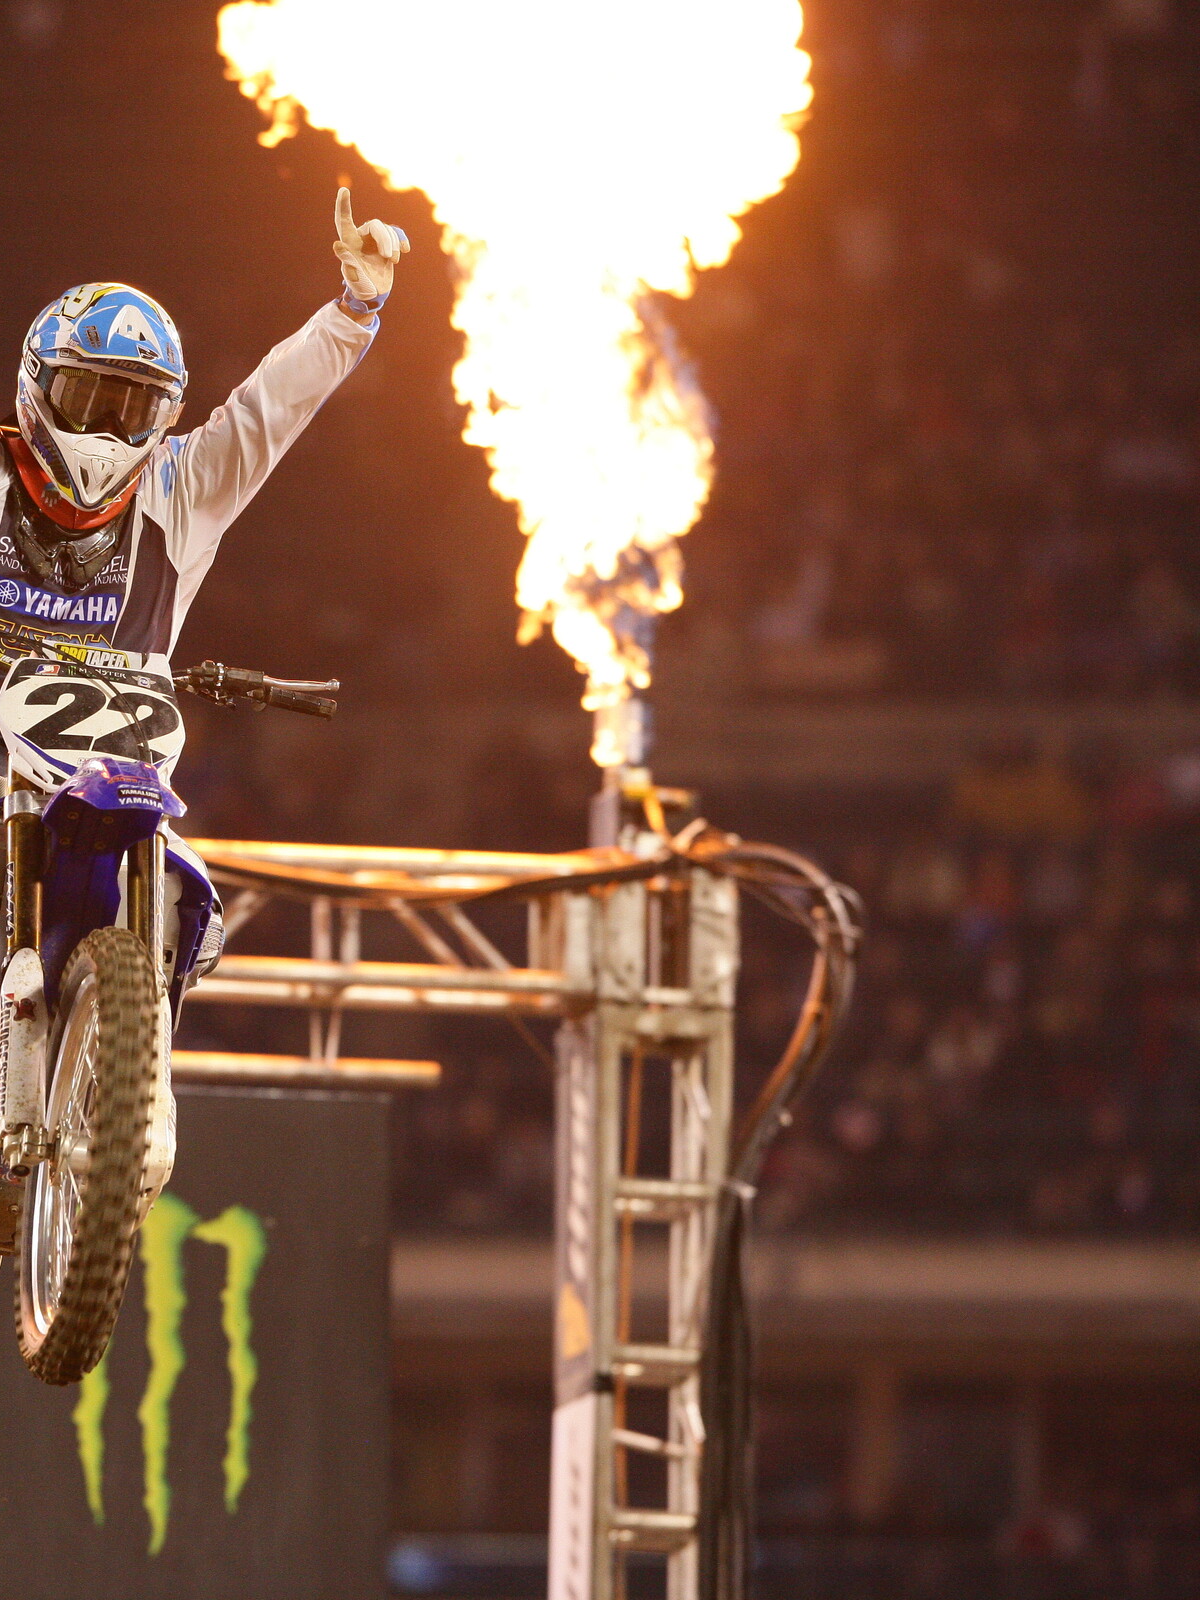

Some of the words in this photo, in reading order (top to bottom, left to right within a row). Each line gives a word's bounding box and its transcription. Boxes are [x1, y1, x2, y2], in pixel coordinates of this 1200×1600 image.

[24, 587, 118, 622] YAMAHA
[78, 667, 127, 679] MNSTER
[21, 682, 179, 764] 22
[118, 797, 164, 810] YAMAHA
